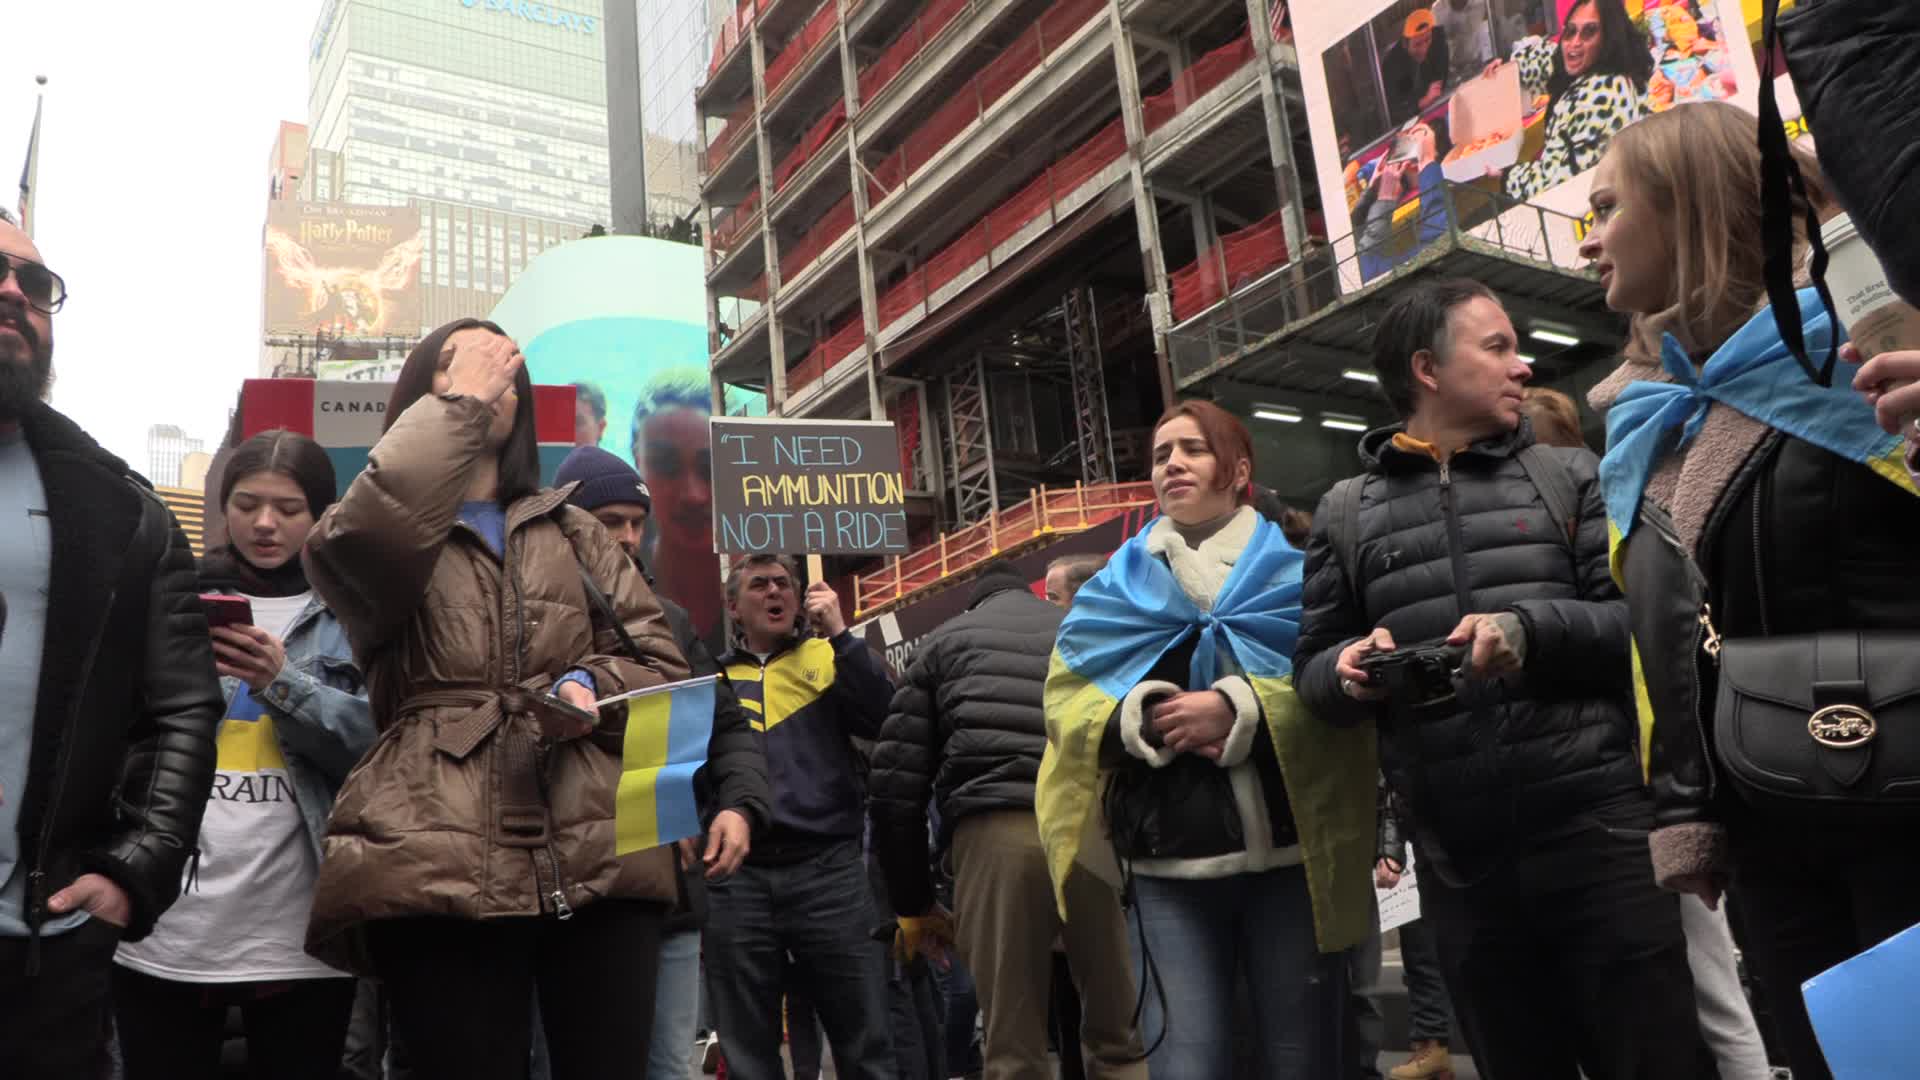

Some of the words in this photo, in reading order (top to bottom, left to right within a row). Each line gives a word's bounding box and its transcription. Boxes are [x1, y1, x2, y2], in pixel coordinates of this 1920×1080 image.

[484, 0, 595, 33] BARCLAYS
[299, 219, 344, 245] Harry
[345, 218, 394, 243] Potter
[773, 435, 863, 466] NEED
[742, 471, 905, 507] AMMUNITION
[721, 512, 793, 550] NOT
[803, 511, 826, 550] A
